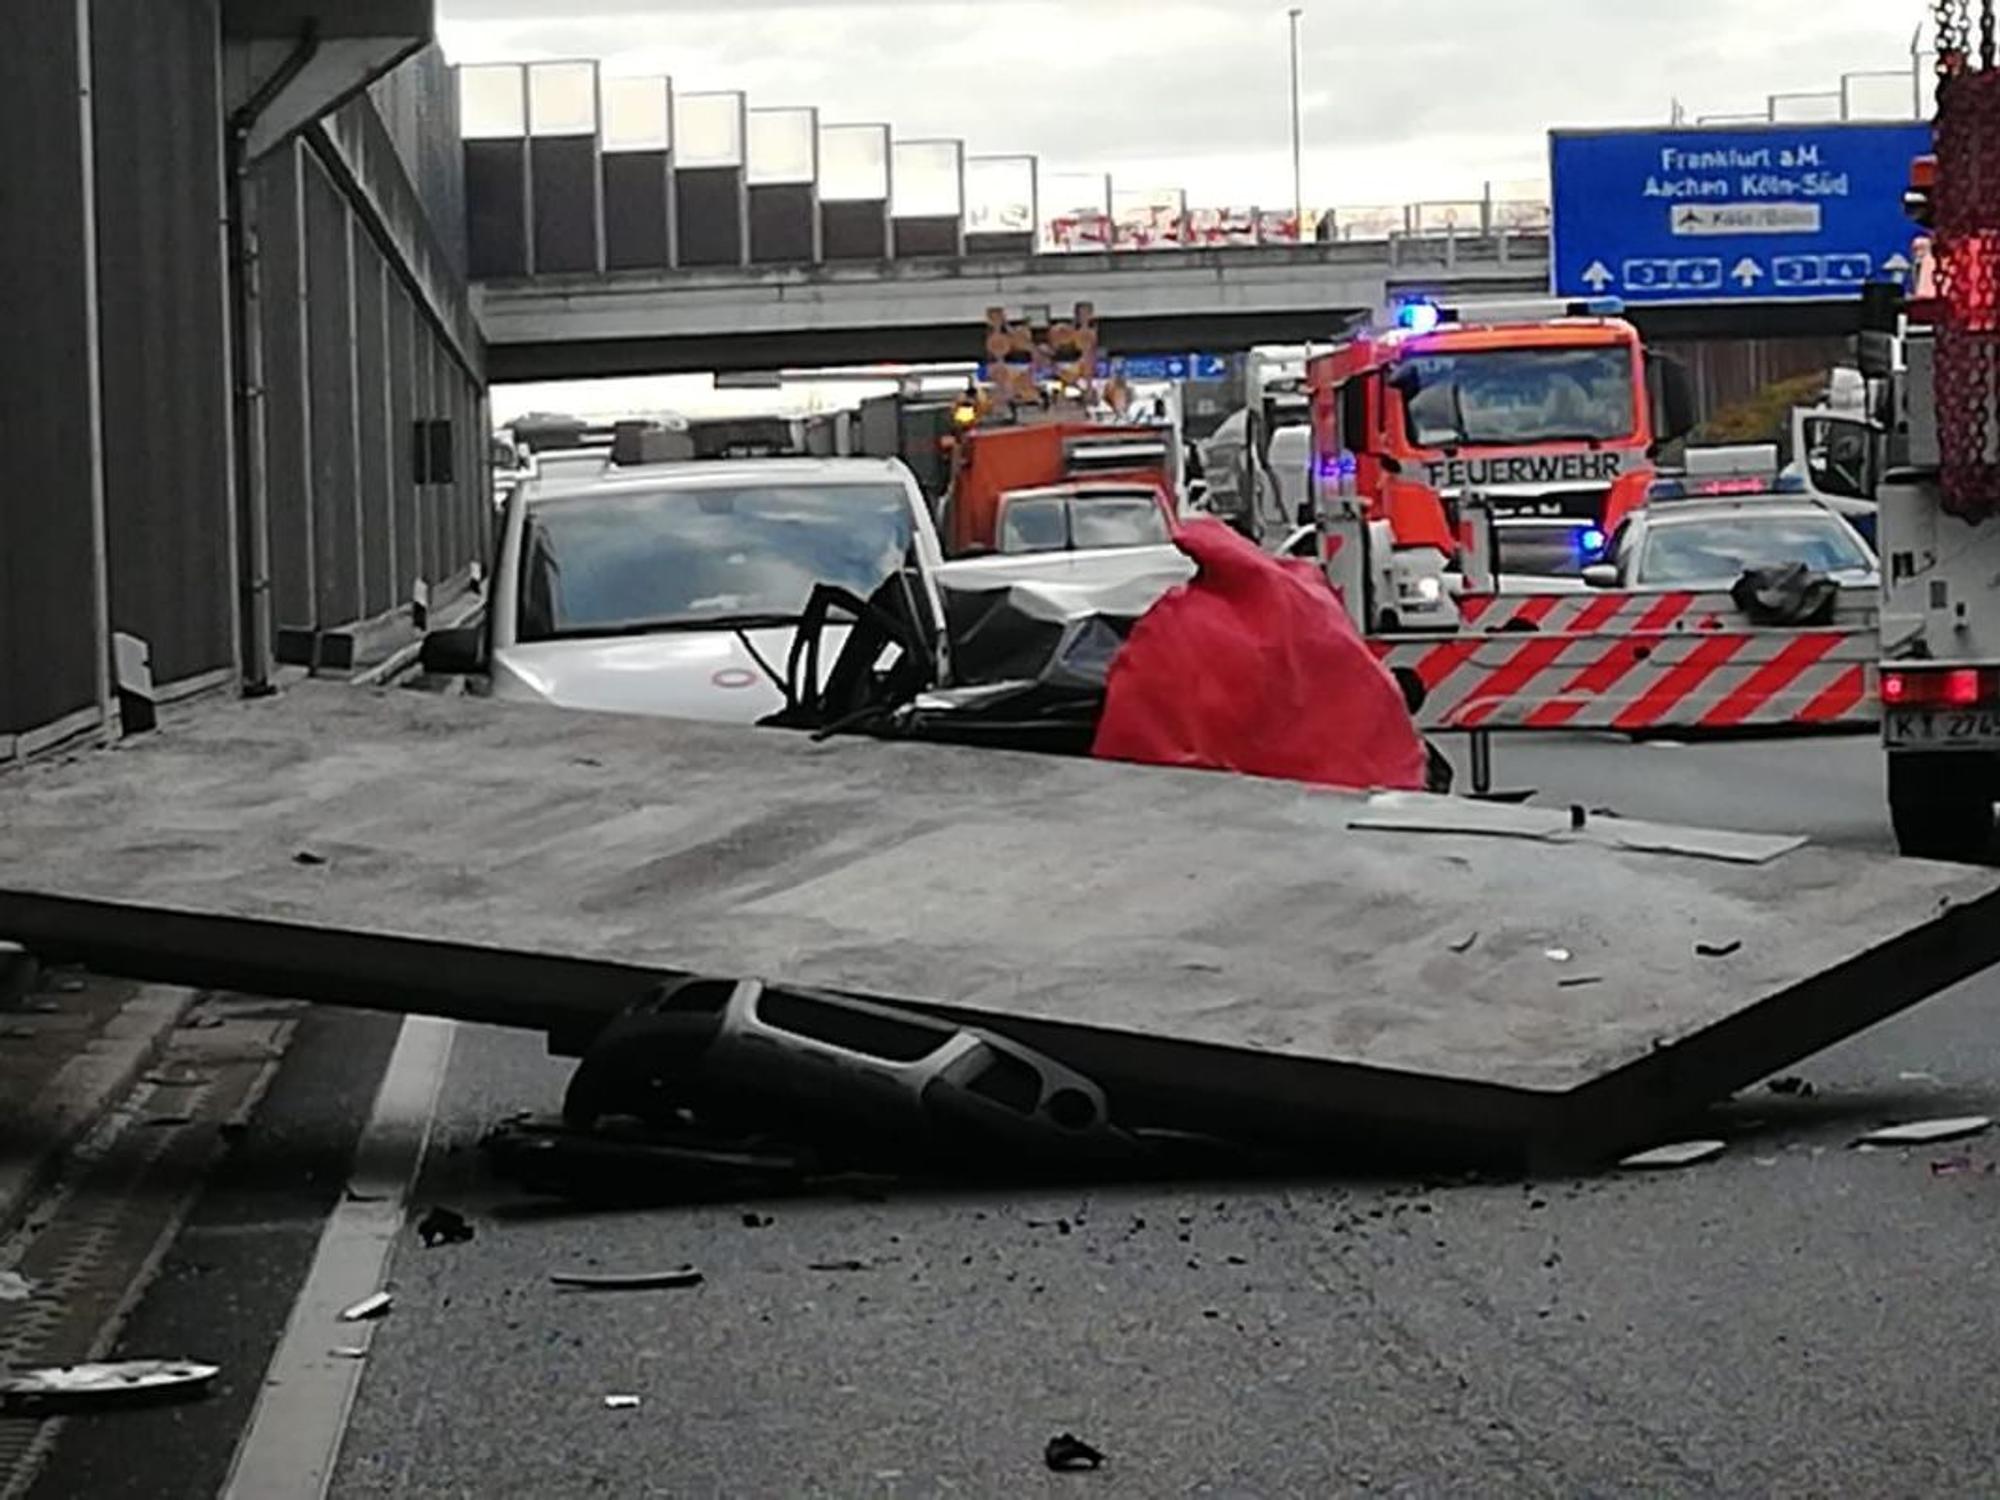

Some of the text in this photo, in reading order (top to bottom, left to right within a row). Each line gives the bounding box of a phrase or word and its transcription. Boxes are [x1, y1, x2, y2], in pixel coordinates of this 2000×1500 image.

[1662, 147, 1771, 171] Frankfurt
[1643, 171, 1848, 197] Aachen Köln-Süd
[1423, 452, 1620, 487] FEUERWEHR
